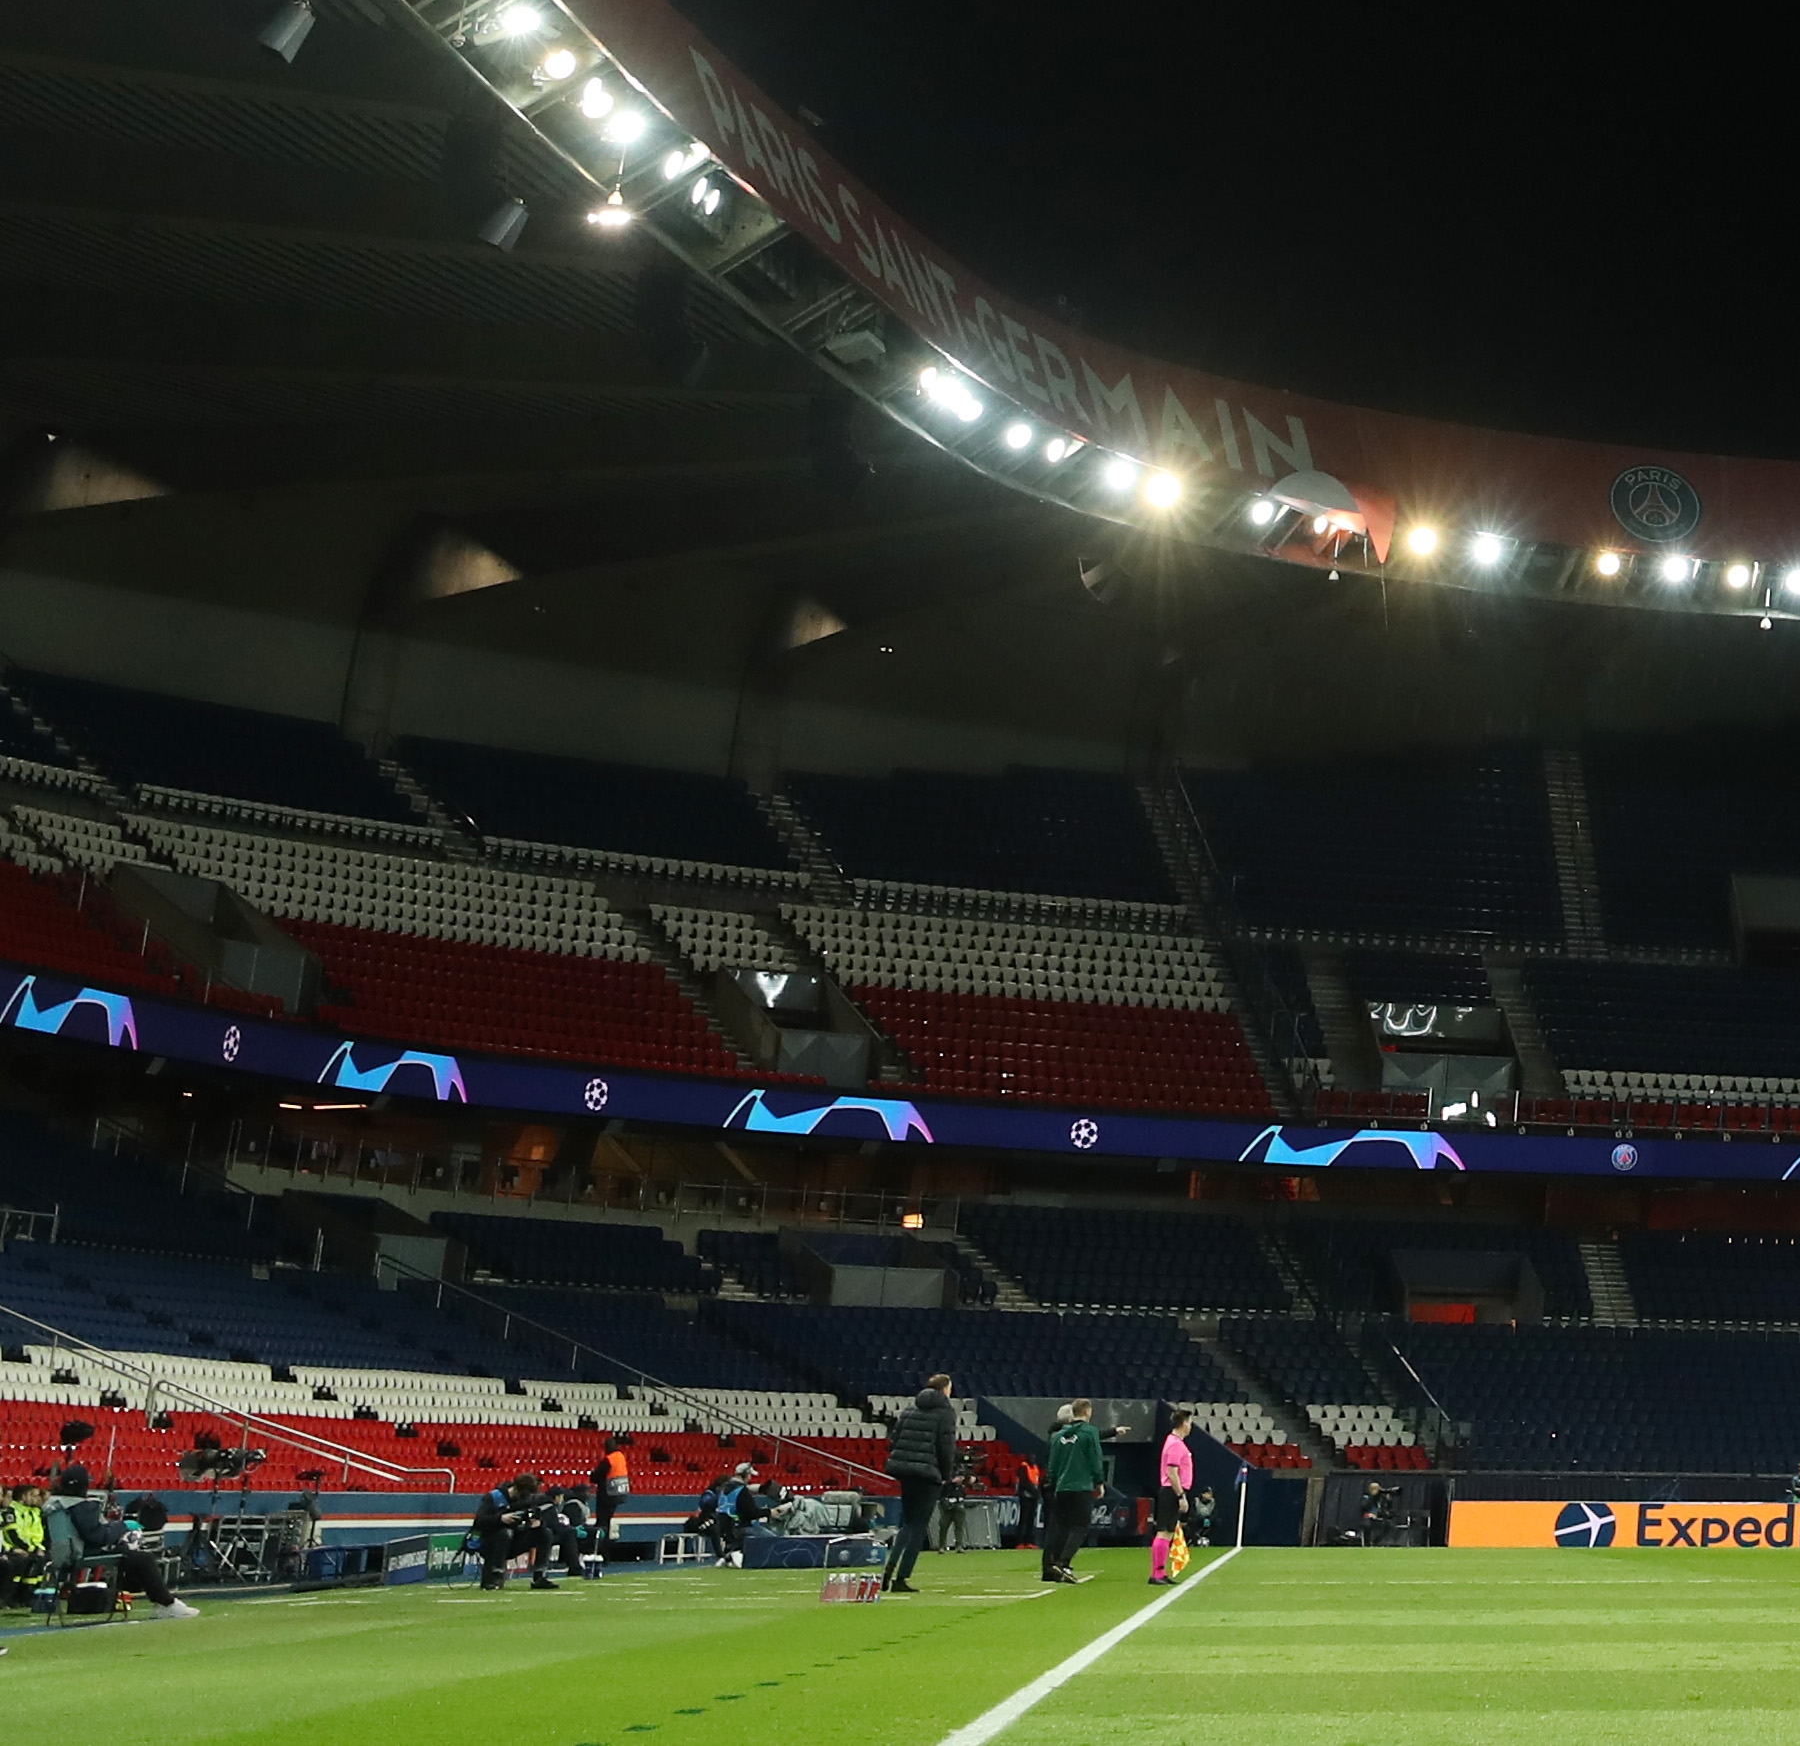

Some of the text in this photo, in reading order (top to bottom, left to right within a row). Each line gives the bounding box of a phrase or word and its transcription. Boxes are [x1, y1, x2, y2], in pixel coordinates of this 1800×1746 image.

[688, 45, 1313, 478] PARIS SAINT-GERMAIN
[1625, 470, 1682, 491] PARIS
